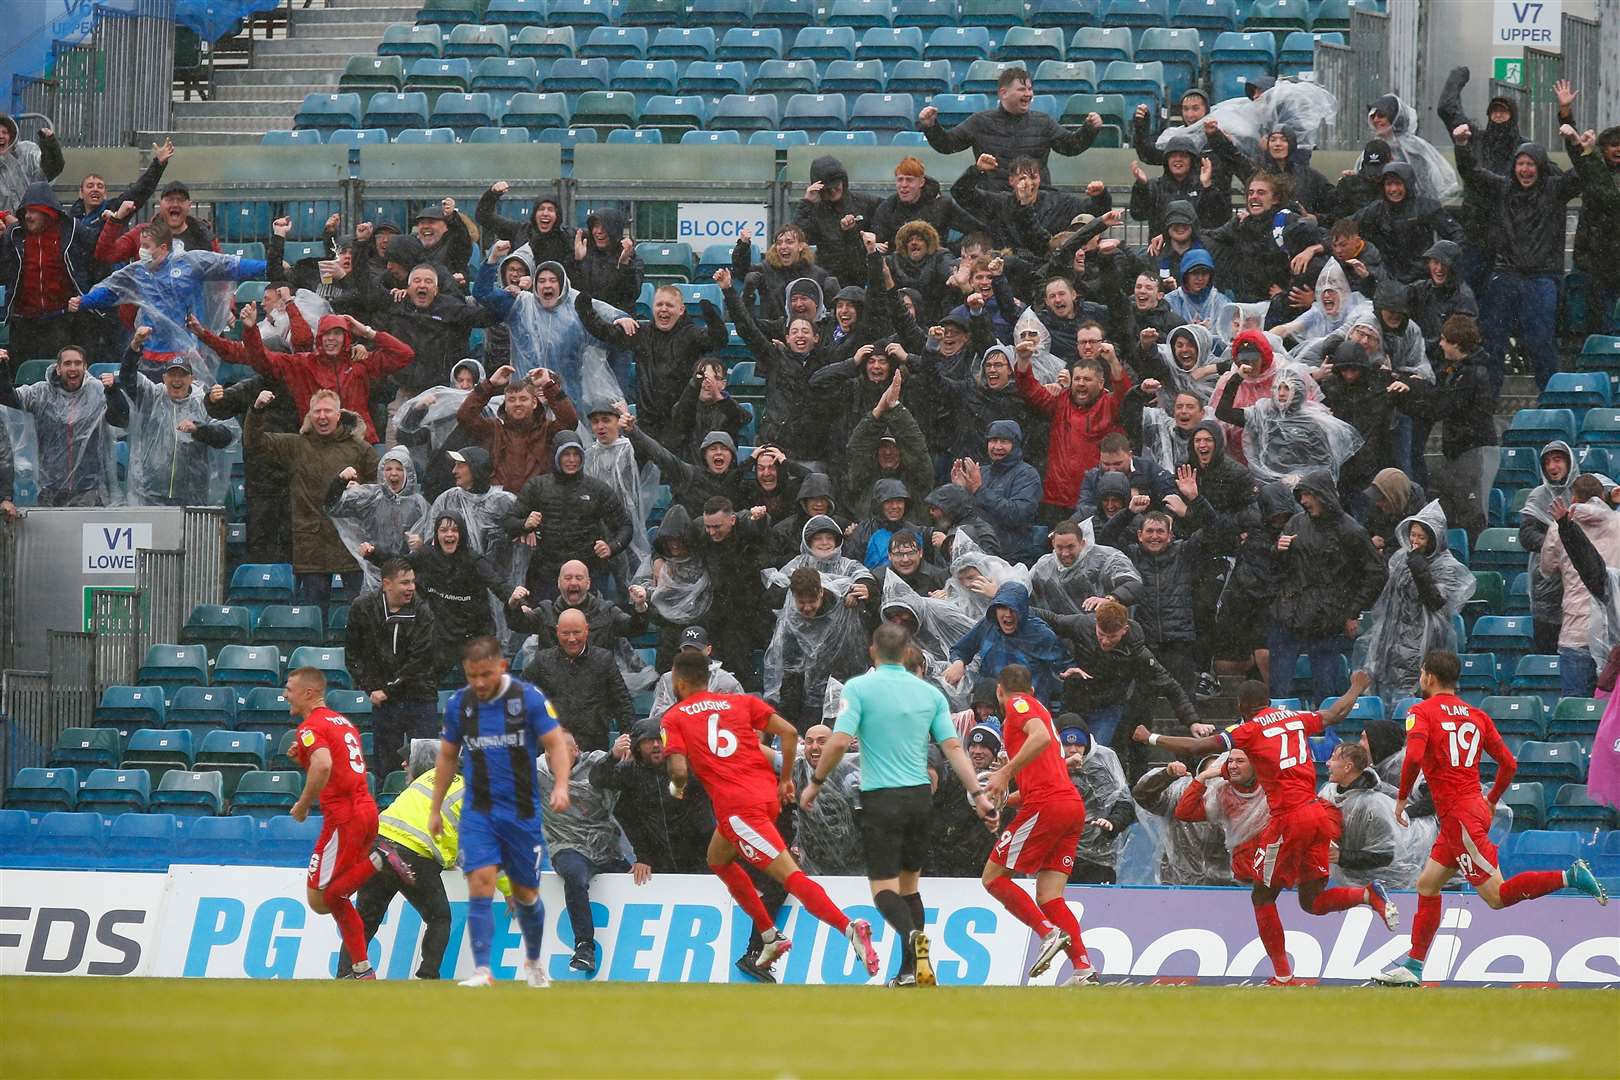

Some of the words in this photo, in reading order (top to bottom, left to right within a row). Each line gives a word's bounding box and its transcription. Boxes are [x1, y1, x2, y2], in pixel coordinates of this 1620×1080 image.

[1512, 2, 1543, 24] V7
[1500, 28, 1552, 41] UPPER
[680, 220, 748, 236] BLOCK
[754, 221, 765, 236] 2
[103, 528, 133, 550] V1
[88, 556, 142, 569] LOWE
[686, 630, 700, 639] NY
[686, 700, 732, 715] COUSINS
[1446, 705, 1470, 717] LANG
[707, 713, 738, 758] 6
[1263, 720, 1307, 770] 27
[1440, 722, 1480, 768] 19
[344, 732, 365, 774] 8
[182, 897, 306, 980] PG
[548, 901, 998, 986] SERVICS
